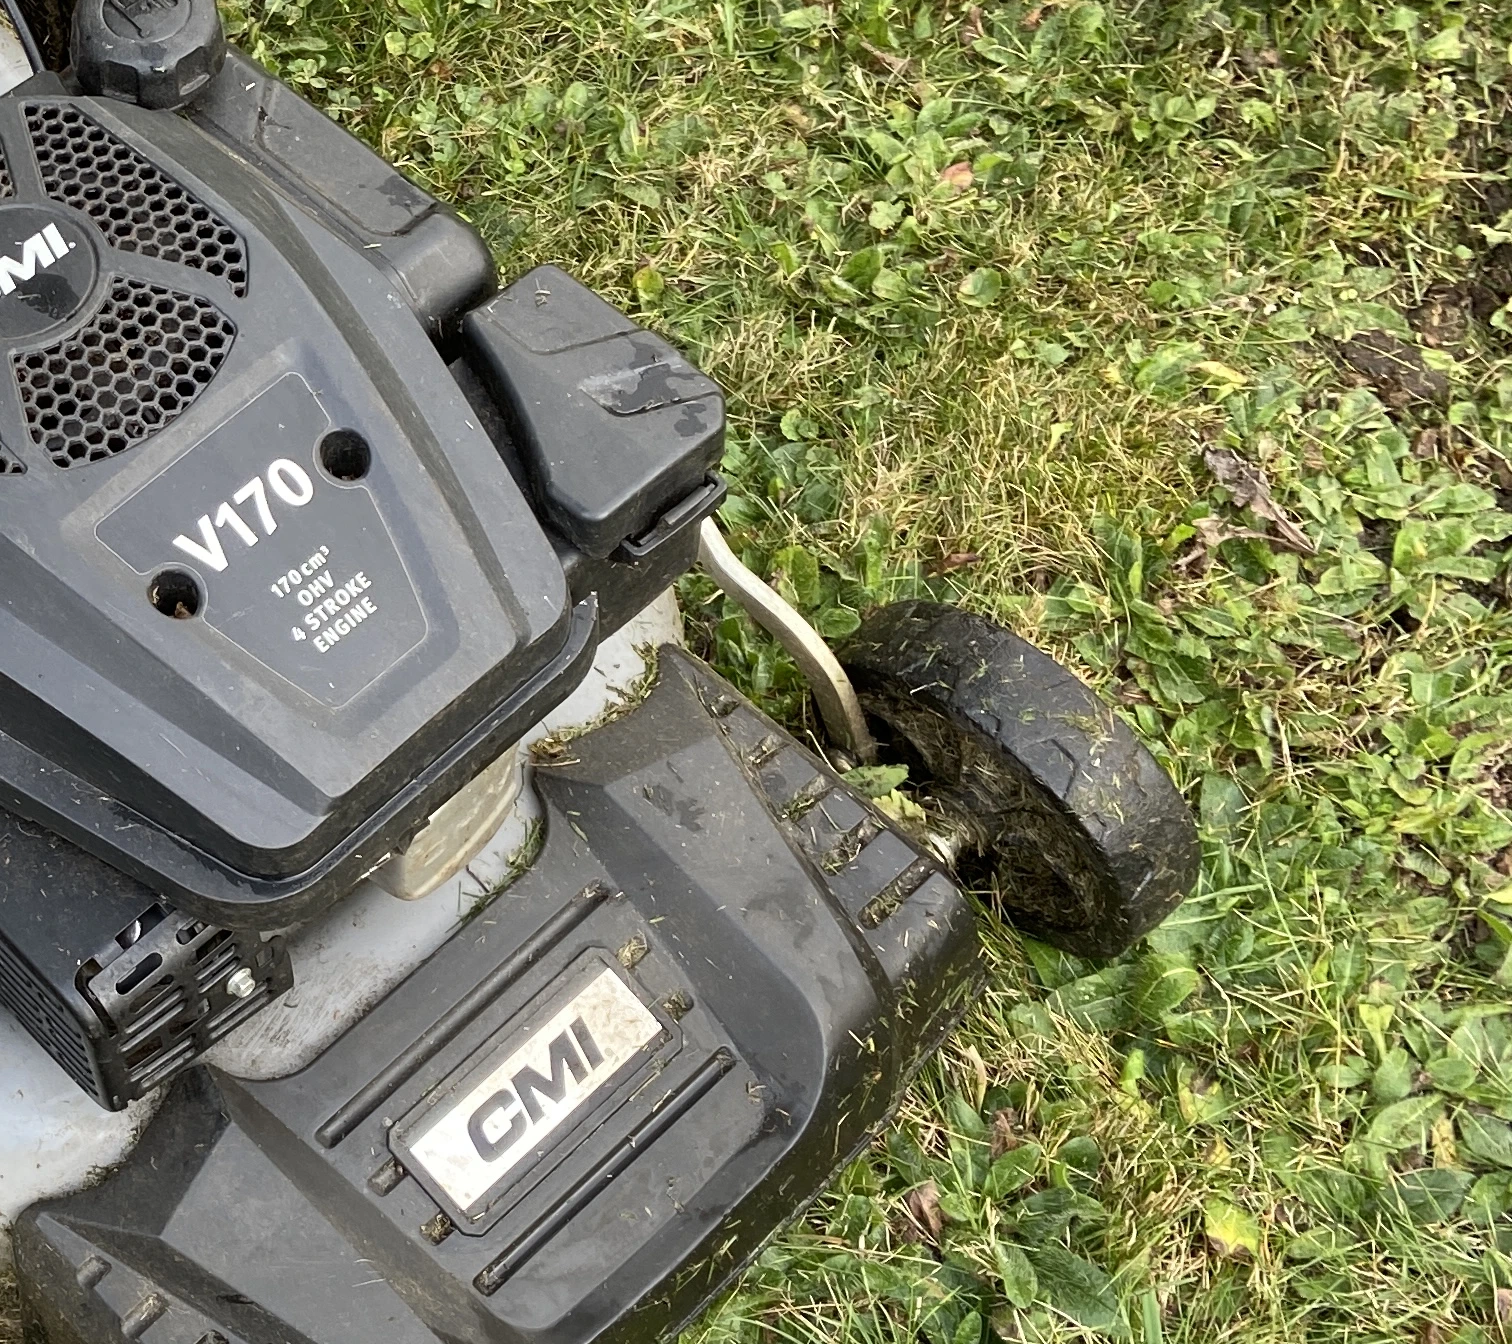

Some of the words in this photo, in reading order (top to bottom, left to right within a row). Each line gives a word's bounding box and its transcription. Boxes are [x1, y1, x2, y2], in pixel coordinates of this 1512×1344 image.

[172, 458, 314, 572] V170
[291, 625, 307, 642] 4
[304, 571, 372, 632] STROKE
[297, 570, 335, 606] OHV
[313, 596, 377, 654] ENGINE
[467, 1015, 605, 1163] CMI
